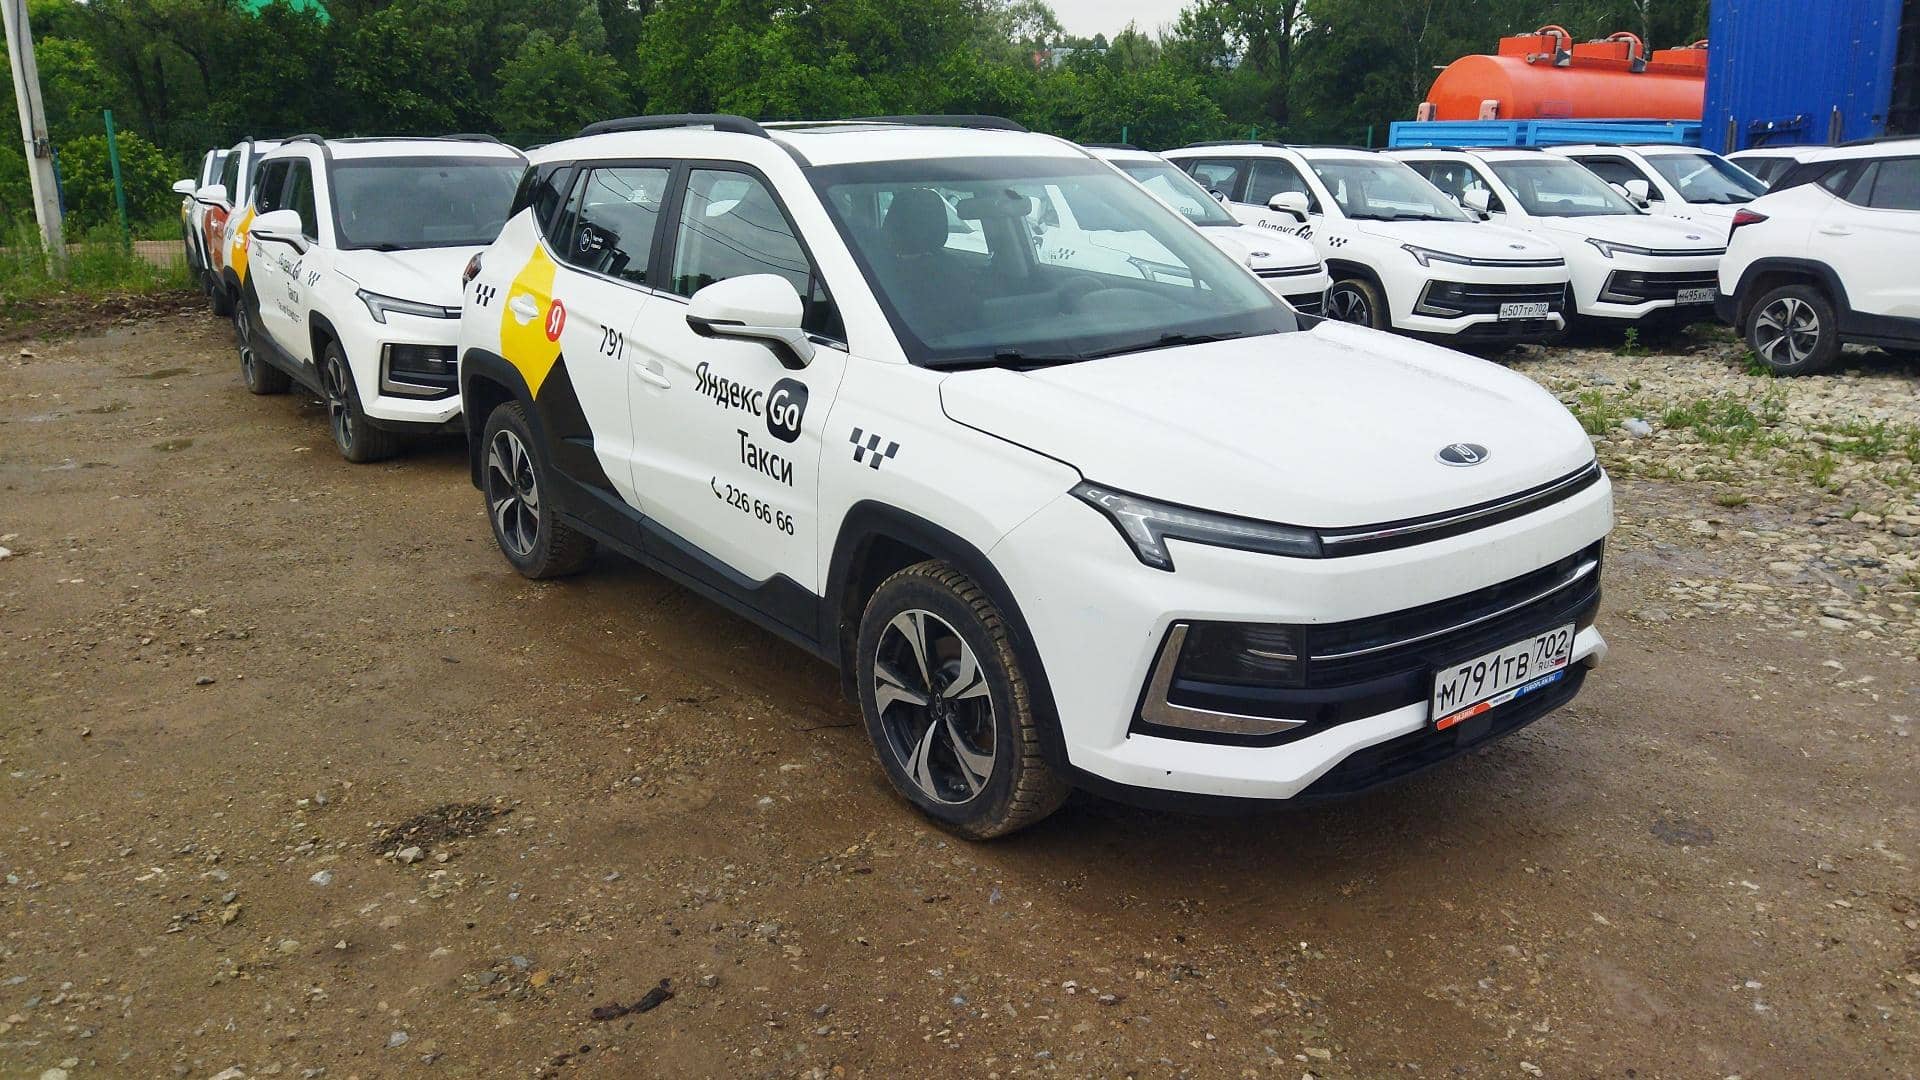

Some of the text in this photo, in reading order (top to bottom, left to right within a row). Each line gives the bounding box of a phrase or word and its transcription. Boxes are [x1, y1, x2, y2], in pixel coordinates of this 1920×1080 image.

[600, 325, 624, 360] 791
[695, 361, 801, 432] Яндекс Go
[737, 429, 793, 487] Такси
[726, 484, 795, 536] 226 66 66
[1440, 630, 1568, 711] М791ТВ 702
[1538, 658, 1556, 671] RUS
